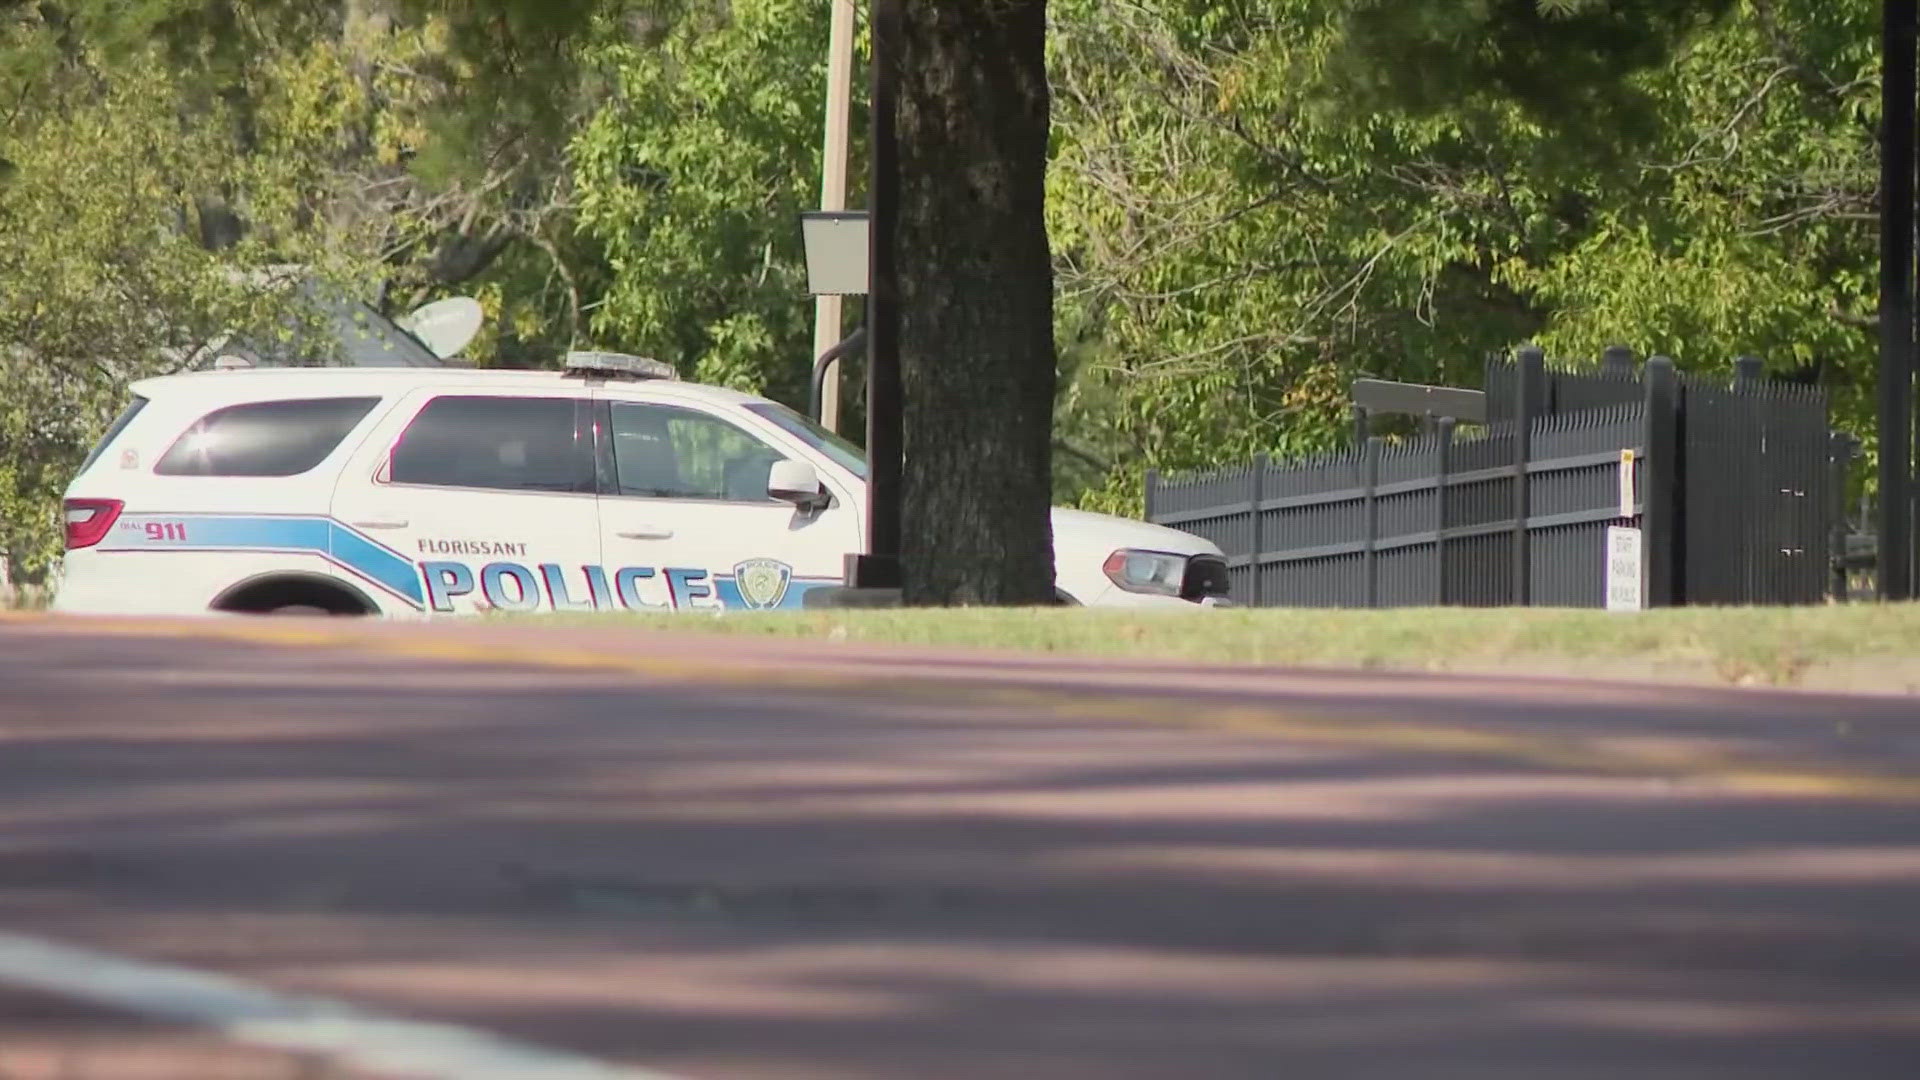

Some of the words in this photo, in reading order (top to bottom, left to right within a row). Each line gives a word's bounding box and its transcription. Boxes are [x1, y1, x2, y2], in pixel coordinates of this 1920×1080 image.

[120, 522, 142, 530] DIAL
[145, 522, 187, 541] 911
[418, 539, 528, 557] FLORISSANT
[419, 561, 721, 612] POLICE
